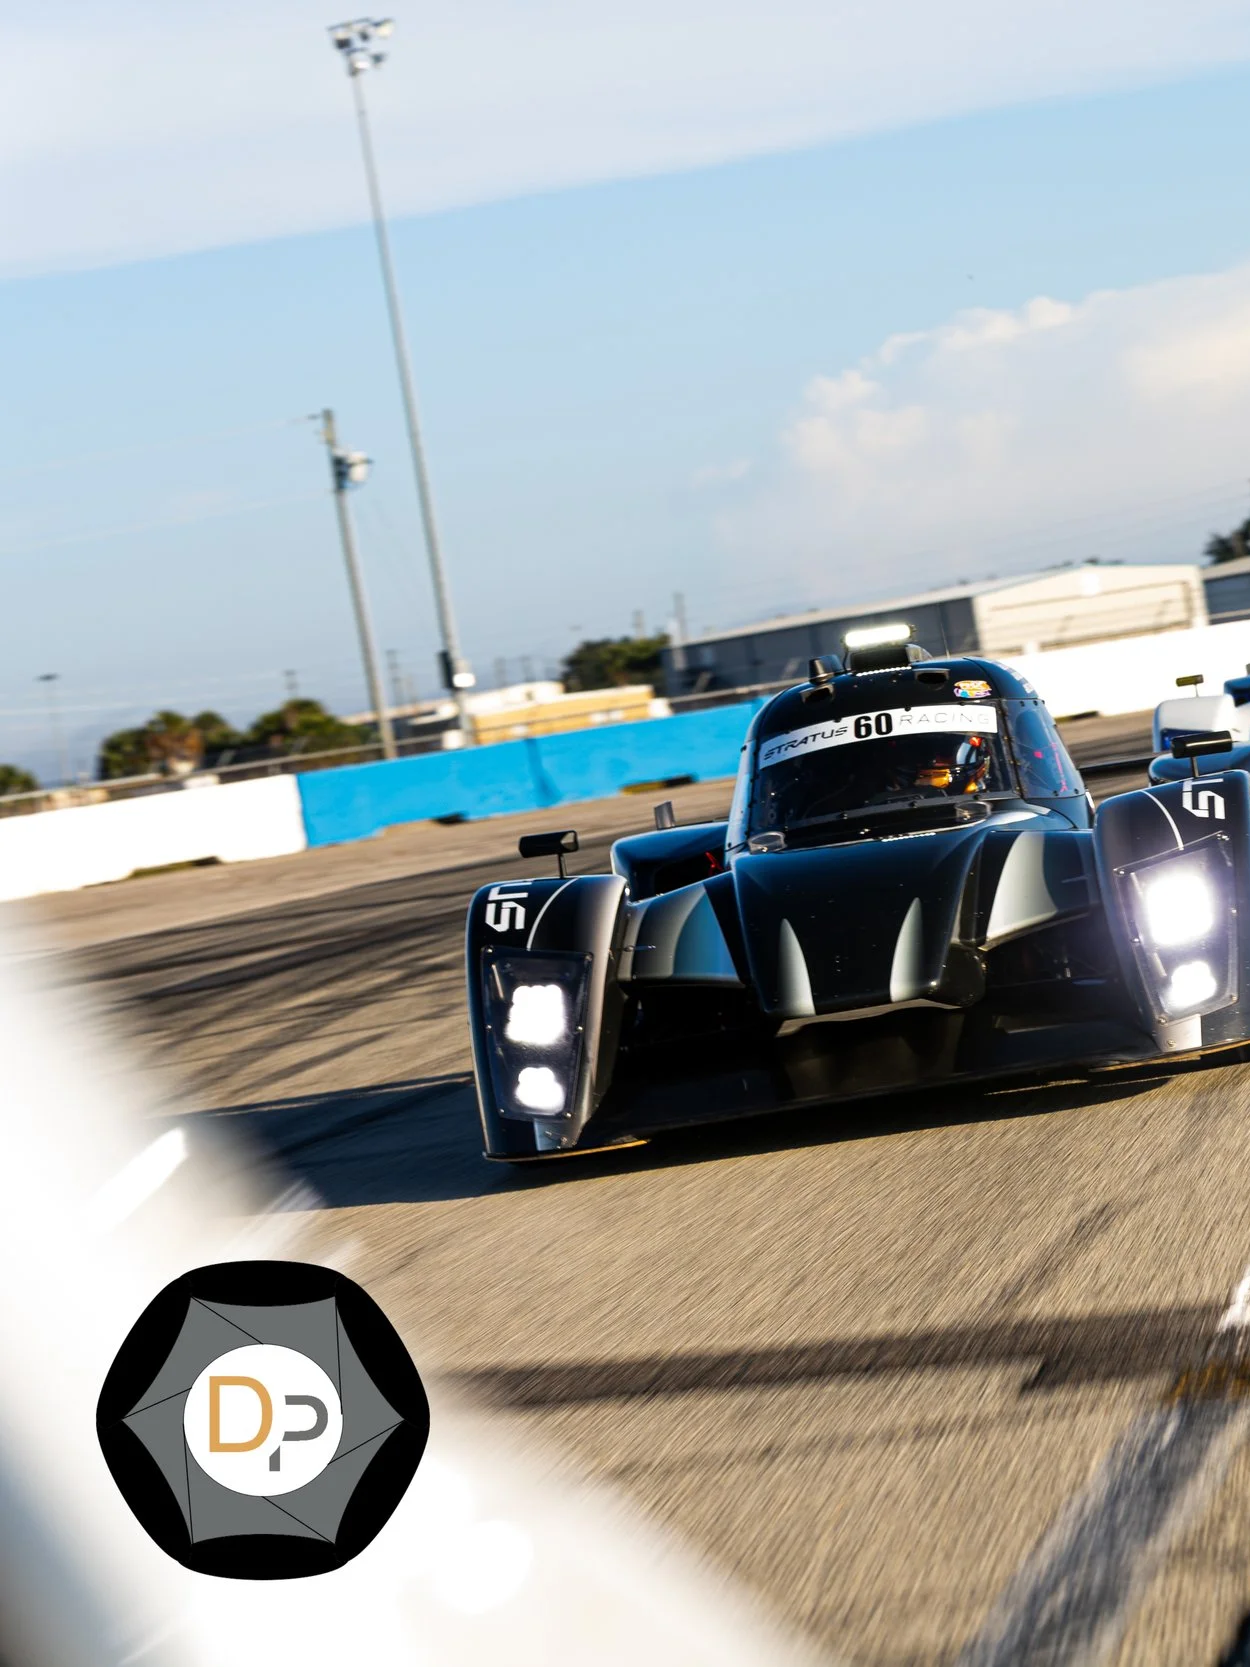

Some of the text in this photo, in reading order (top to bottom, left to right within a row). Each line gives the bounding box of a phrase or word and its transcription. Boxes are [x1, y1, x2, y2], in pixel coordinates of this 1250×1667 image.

[764, 711, 989, 761] STRATUS 60 RACING
